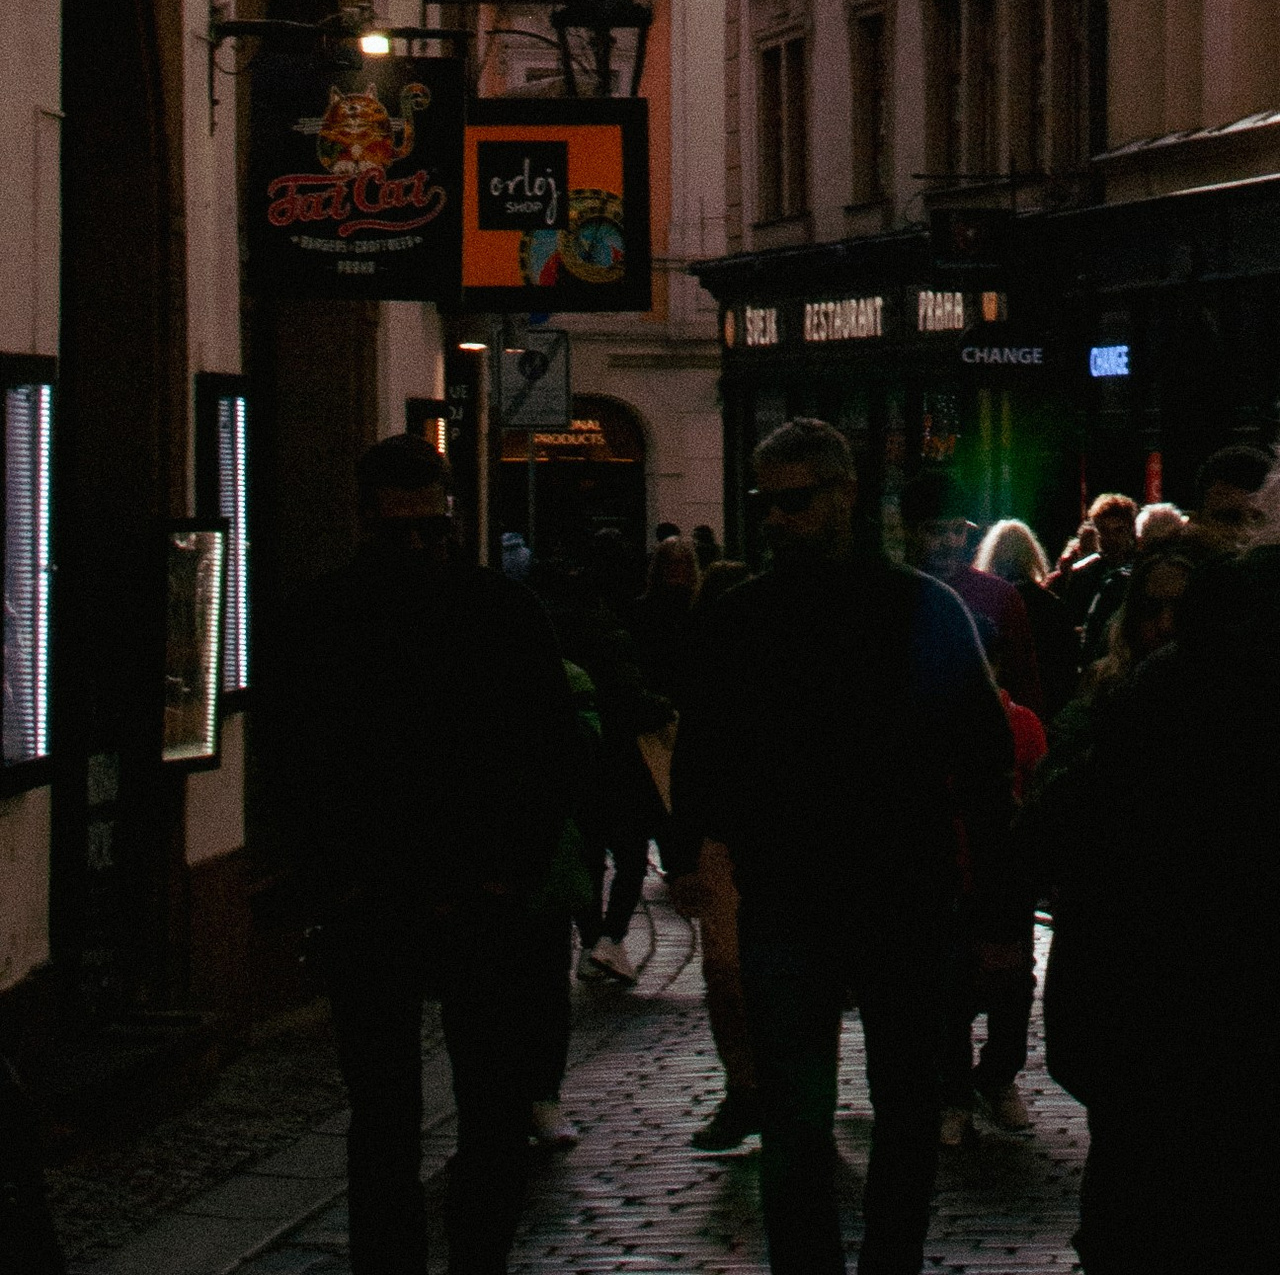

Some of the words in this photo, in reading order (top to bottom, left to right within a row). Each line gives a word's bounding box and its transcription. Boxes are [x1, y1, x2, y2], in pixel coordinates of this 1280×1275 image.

[266, 172, 352, 228] Fat
[345, 167, 448, 226] Cat
[489, 157, 561, 226] orloj
[504, 200, 543, 214] SHOP
[803, 295, 883, 342] RESTAURANT
[961, 346, 1043, 364] CHANGE
[533, 431, 606, 446] PRODUCTS
